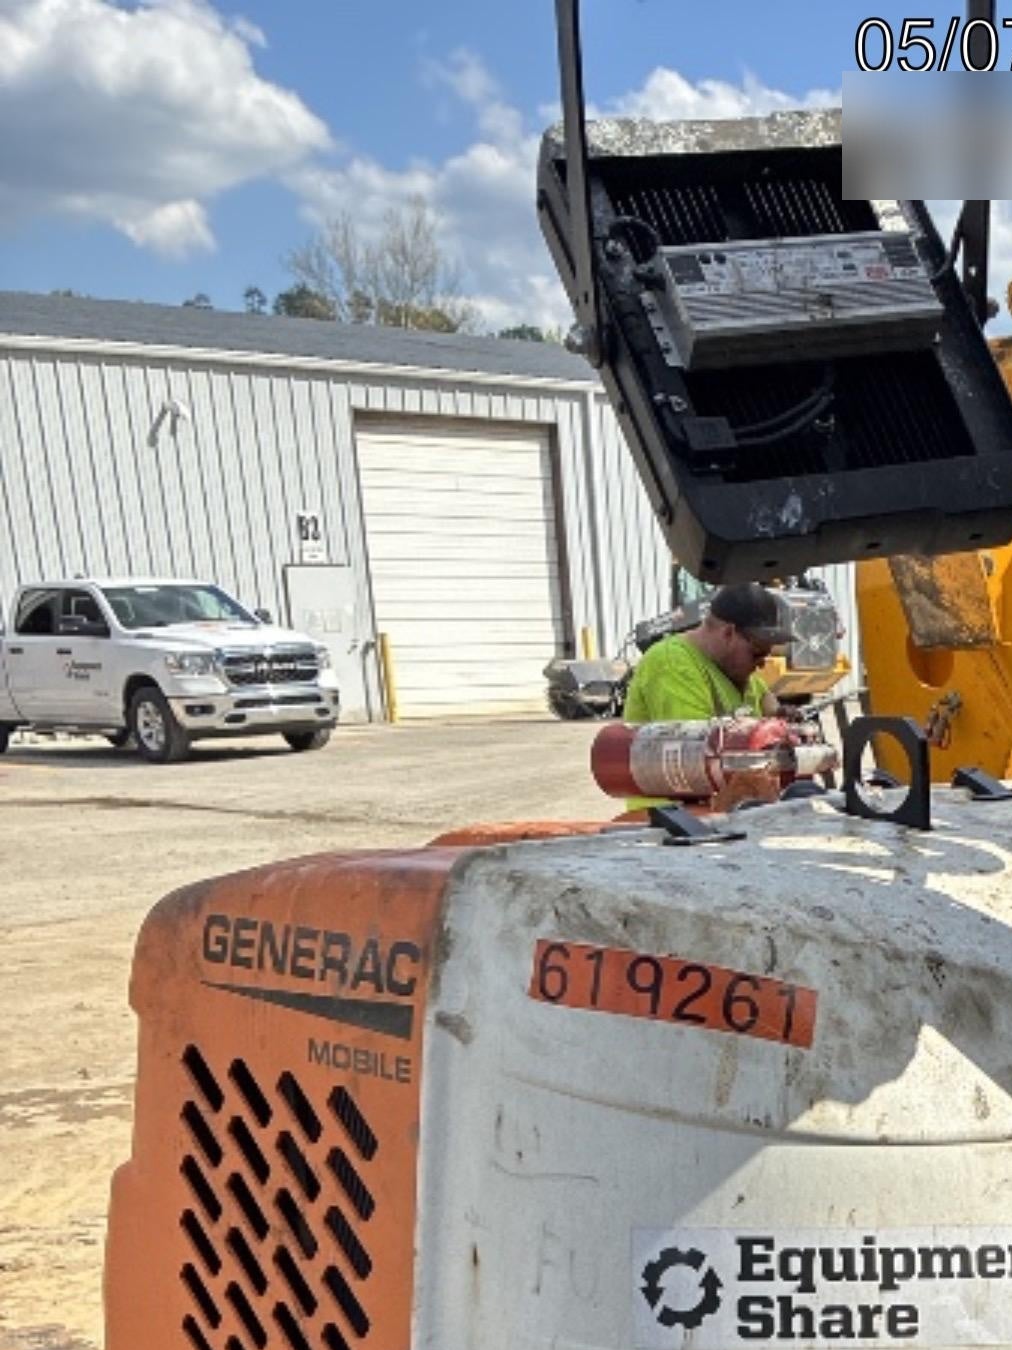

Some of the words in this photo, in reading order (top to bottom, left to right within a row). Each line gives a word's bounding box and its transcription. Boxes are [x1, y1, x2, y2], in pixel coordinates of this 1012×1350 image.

[203, 914, 420, 997] GENERAC
[537, 942, 797, 1041] 619261
[307, 1038, 412, 1084] MOBILE
[736, 1296, 919, 1339] Share
